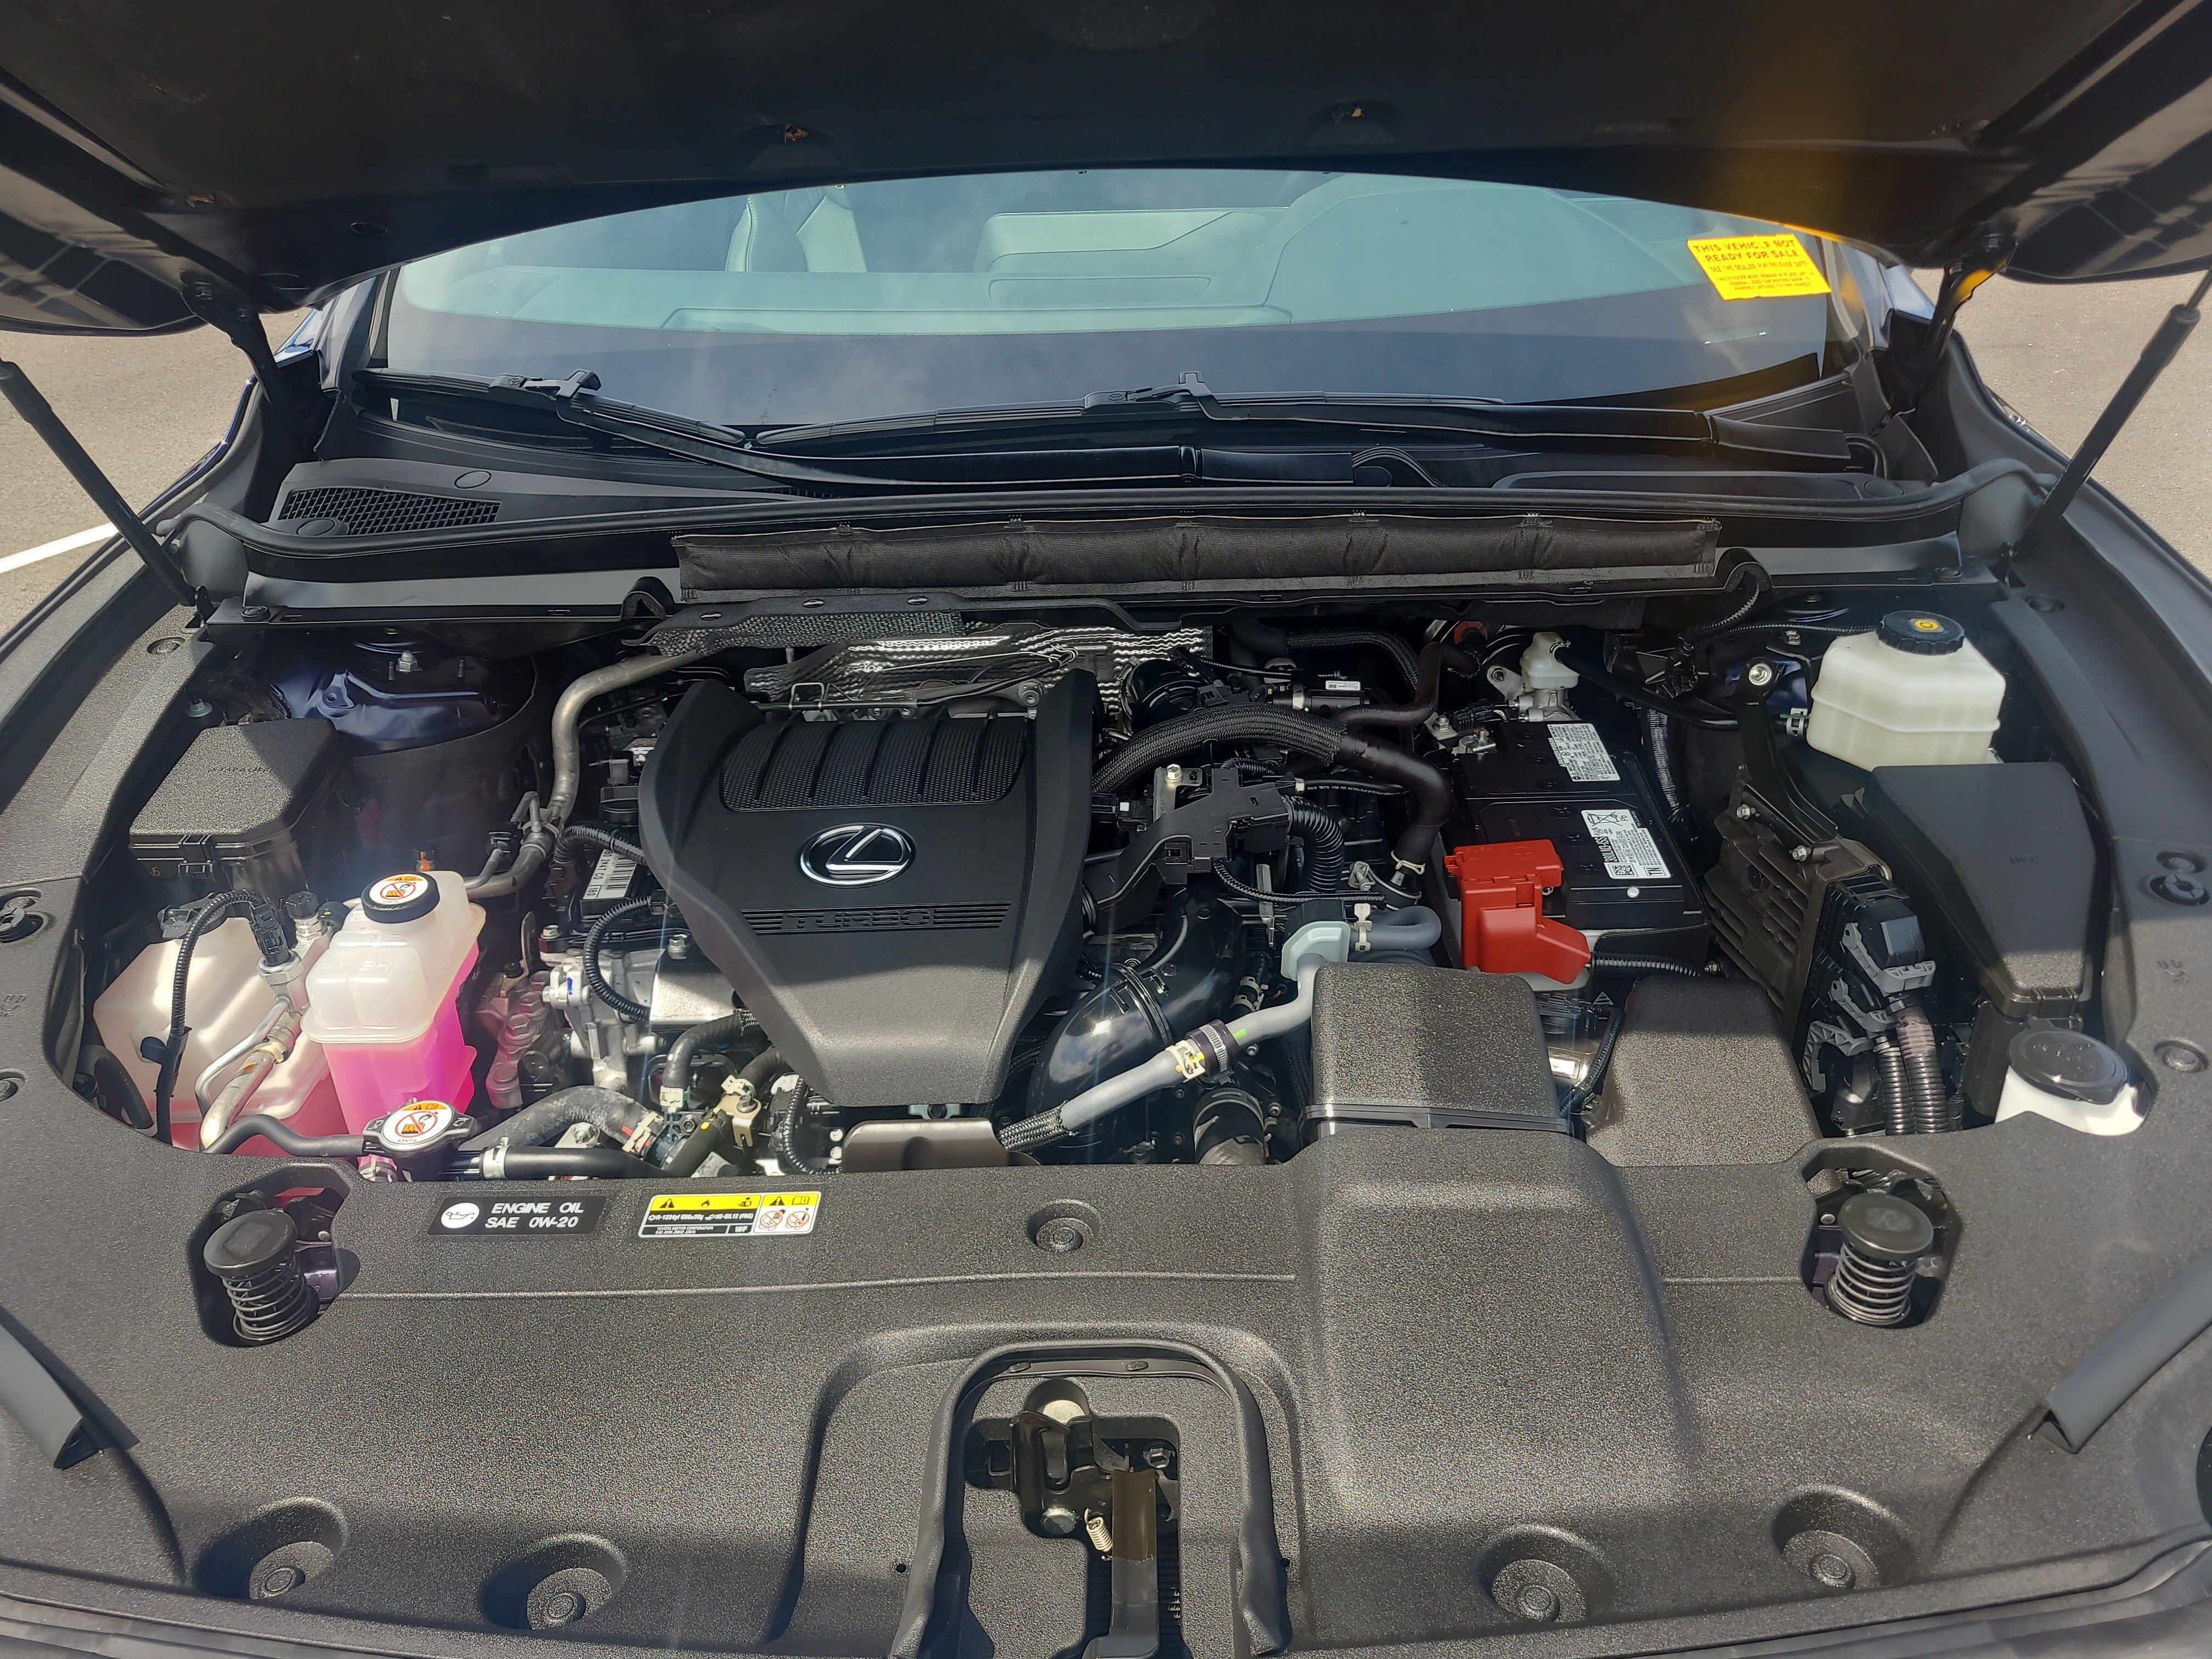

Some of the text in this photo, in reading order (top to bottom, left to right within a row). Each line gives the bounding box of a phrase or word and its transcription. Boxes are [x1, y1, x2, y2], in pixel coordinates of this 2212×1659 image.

[1693, 239, 1796, 253] THIS VEHICLE NOT
[1705, 249, 1800, 262] READY FOR SALE
[149, 867, 160, 876] J5
[1646, 867, 1663, 876] TN
[586, 887, 599, 896] 180
[787, 909, 930, 928] TURBO
[490, 1201, 584, 1214] ENGINE OIL
[485, 1216, 579, 1228] SAE 0W-20
